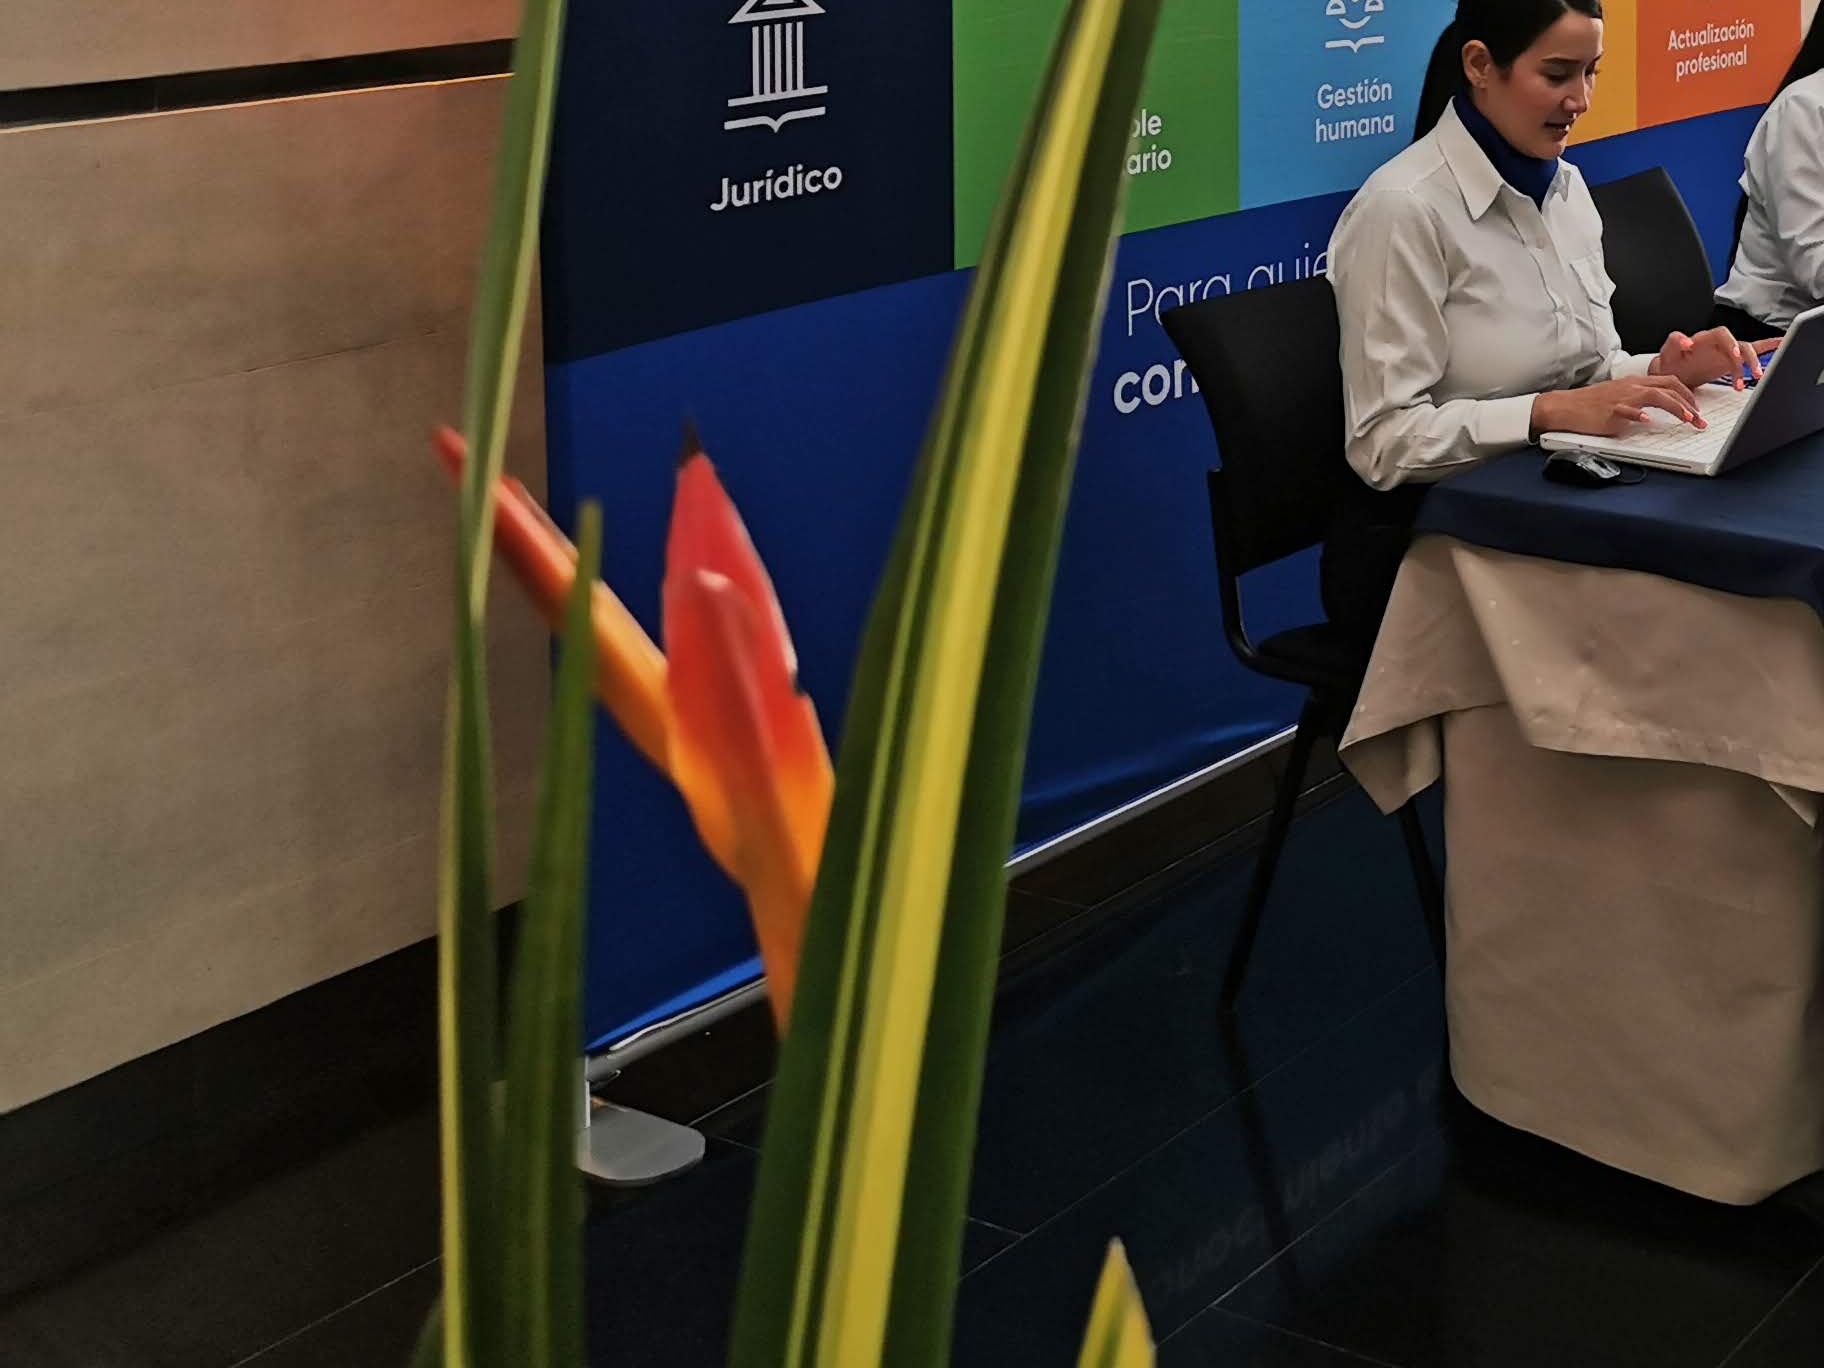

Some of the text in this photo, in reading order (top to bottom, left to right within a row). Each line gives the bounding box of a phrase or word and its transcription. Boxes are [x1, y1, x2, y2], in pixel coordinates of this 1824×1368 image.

[1667, 18, 1755, 51] Actualización
[1675, 43, 1748, 83] profesional
[1317, 77, 1393, 110] Gestión
[1315, 114, 1395, 144] humana
[709, 163, 843, 212] Jurídico
